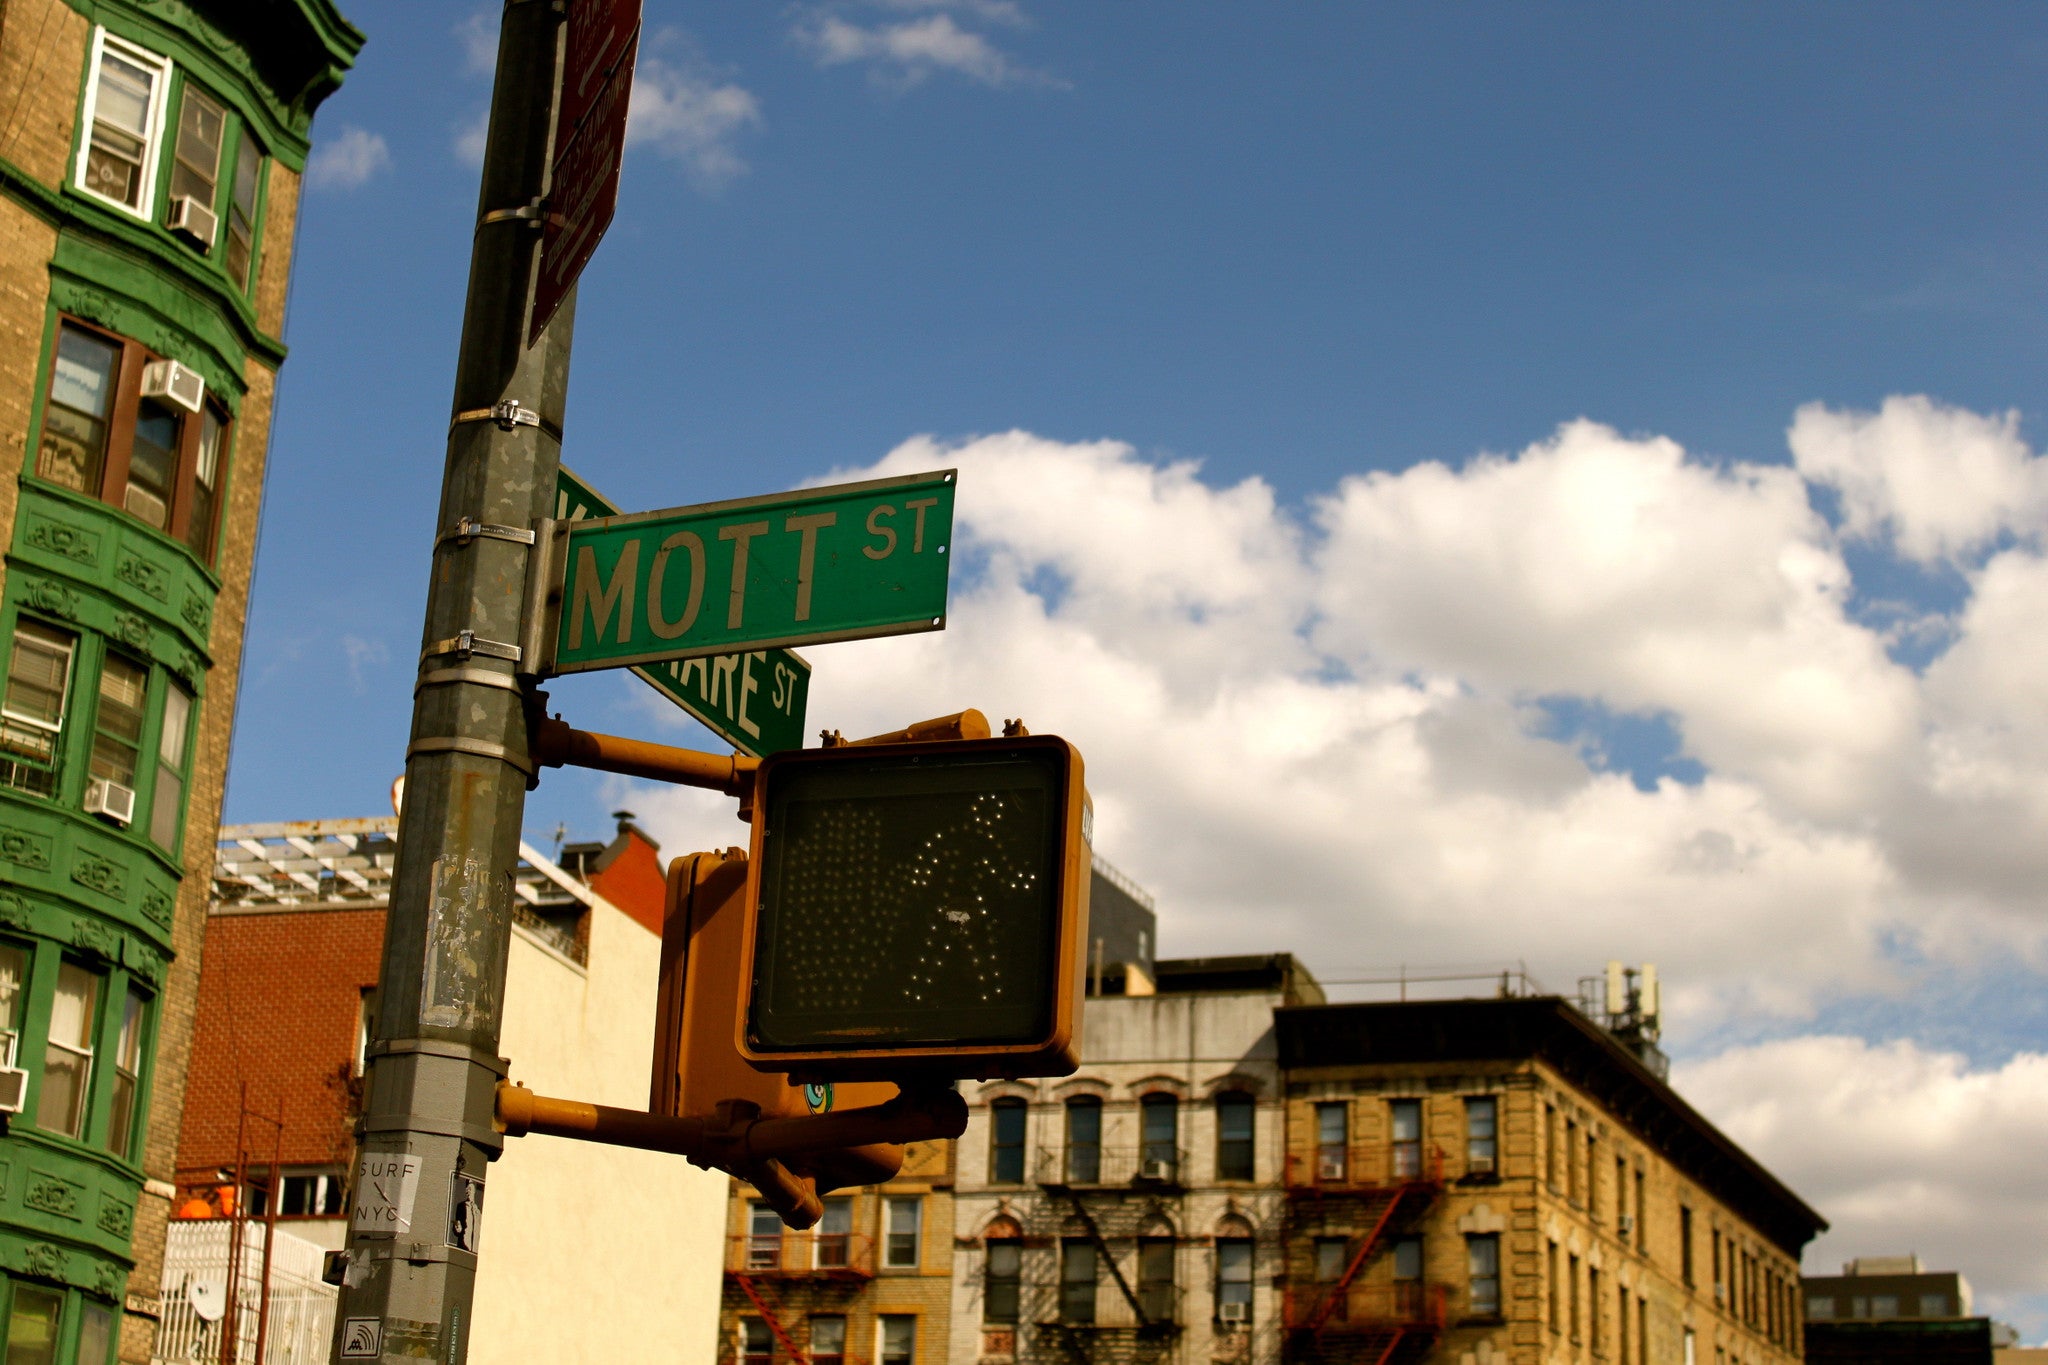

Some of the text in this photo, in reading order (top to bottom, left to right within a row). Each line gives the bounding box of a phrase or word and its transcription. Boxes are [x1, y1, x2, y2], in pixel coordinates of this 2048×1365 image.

[568, 497, 938, 651] MOTT ST
[772, 661, 798, 717] ST
[360, 1161, 415, 1178] SURF
[356, 1206, 398, 1222] NYC
